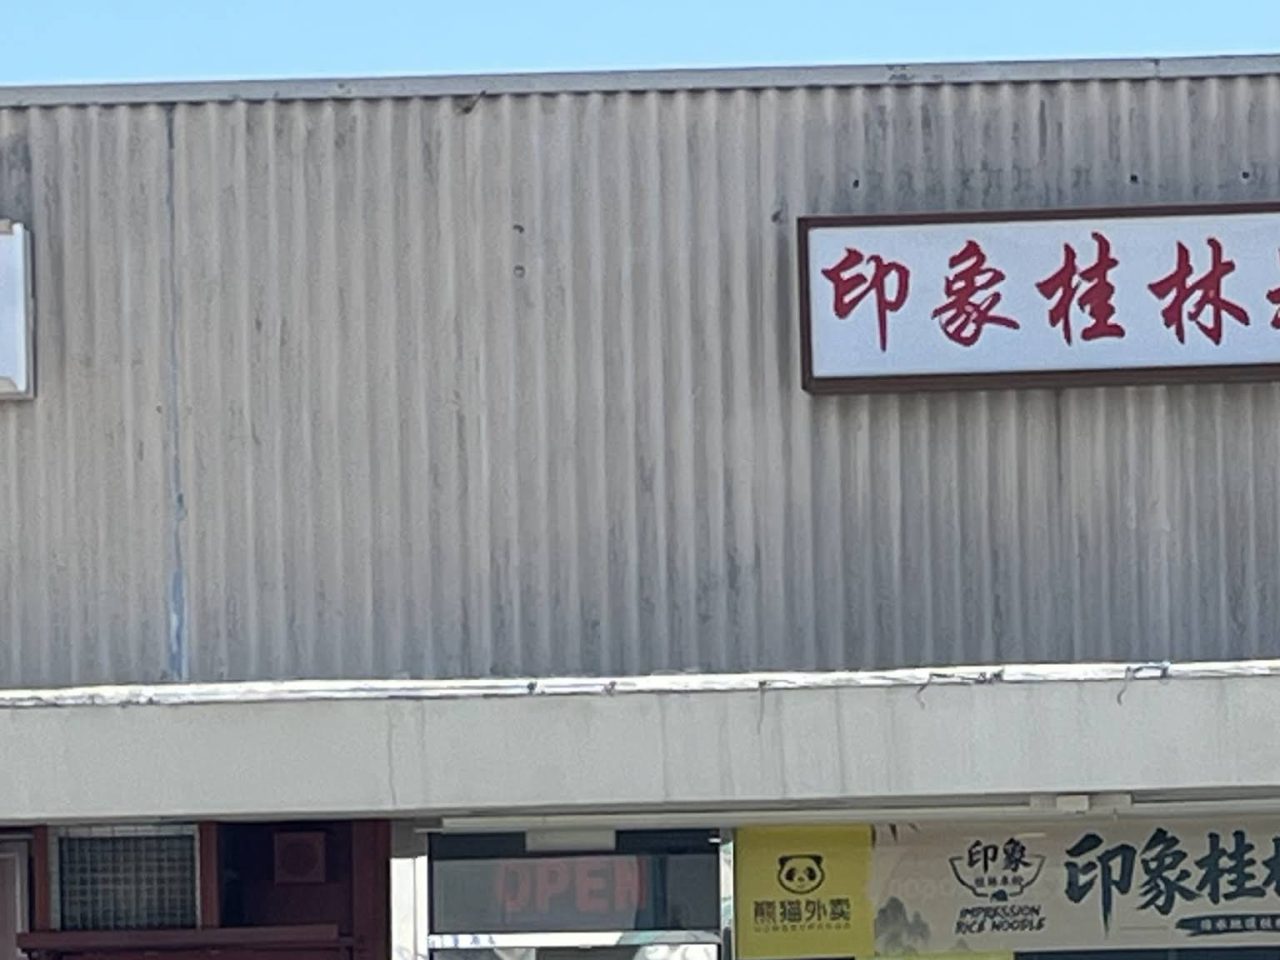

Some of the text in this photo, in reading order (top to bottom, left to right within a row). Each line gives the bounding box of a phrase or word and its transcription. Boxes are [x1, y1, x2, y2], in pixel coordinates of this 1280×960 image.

[968, 838, 1033, 874] 印象
[499, 854, 646, 914] OPEN
[753, 898, 851, 923] 熊猫外卖
[960, 904, 1041, 919] IMPRESSION
[955, 917, 1047, 934] RICE NOODLE
